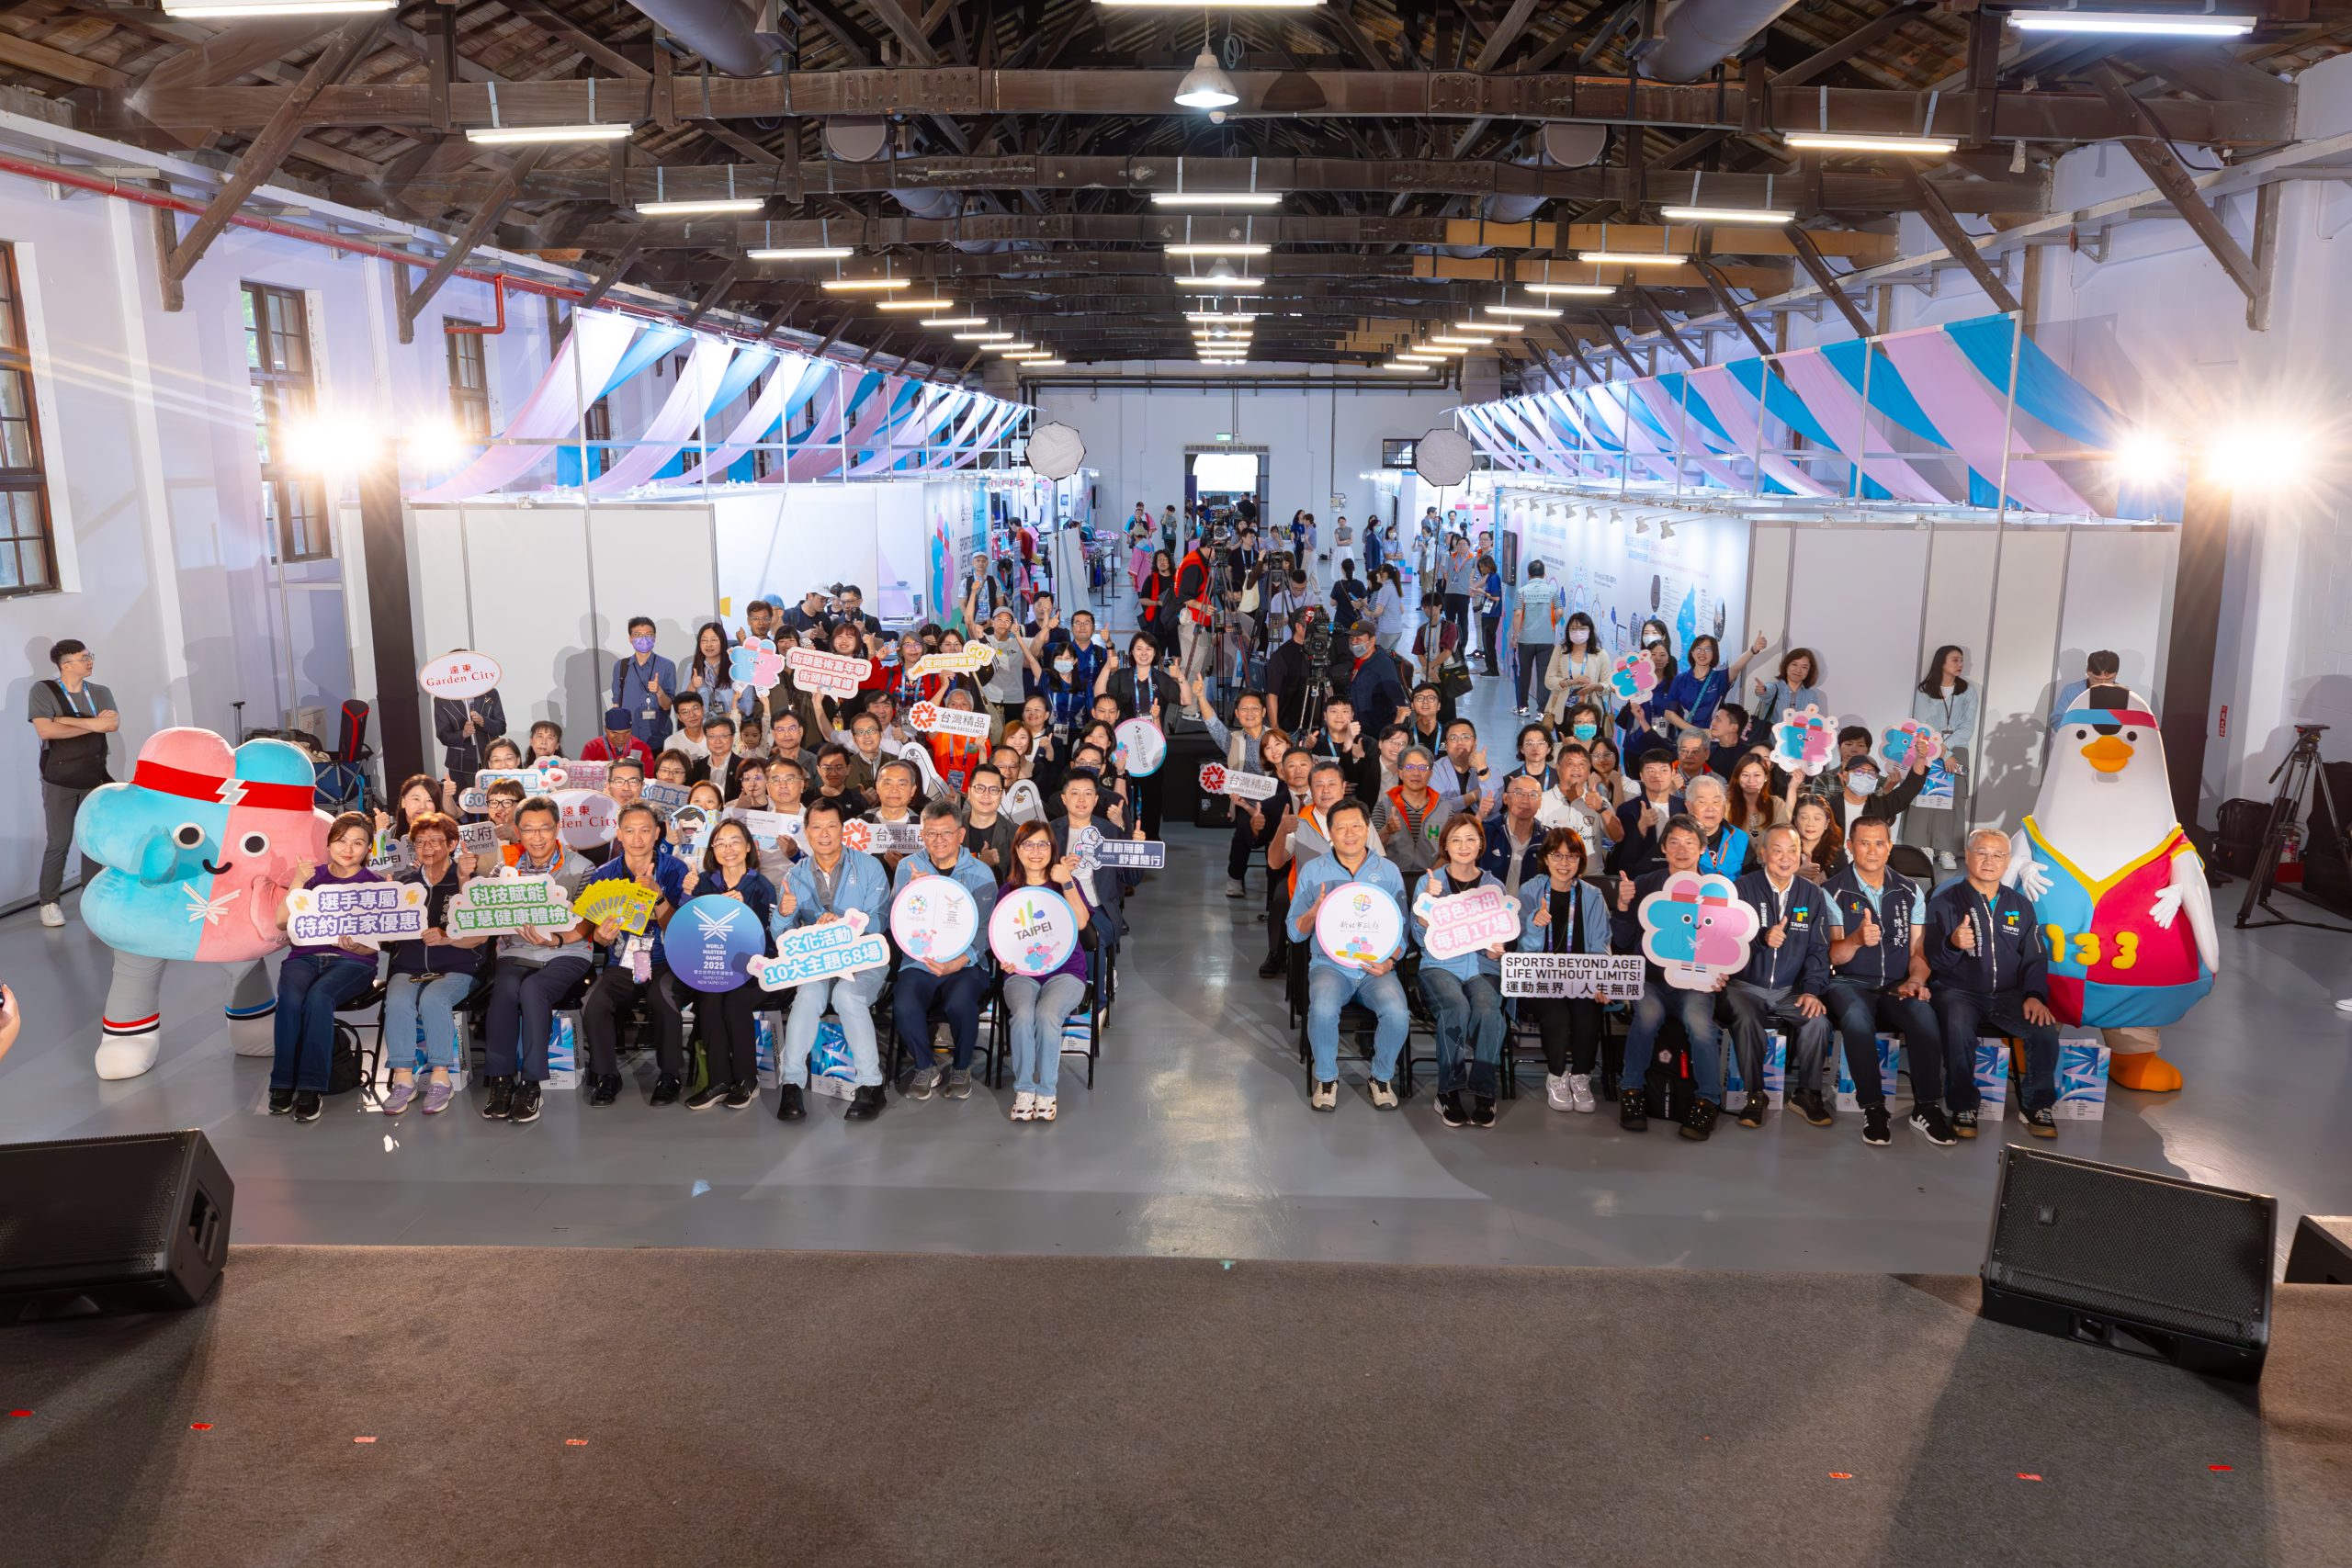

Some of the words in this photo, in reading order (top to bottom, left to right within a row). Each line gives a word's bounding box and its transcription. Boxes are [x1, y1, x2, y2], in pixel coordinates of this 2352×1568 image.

[967, 644, 990, 661] GO!
[426, 675, 467, 687] Garden
[471, 671, 495, 681] City
[940, 711, 986, 728] 台灣精品
[957, 725, 984, 735] EXCELLENCE
[1229, 773, 1273, 792] 台灣精品
[562, 805, 590, 817] 遠東
[590, 816, 618, 831] City
[319, 888, 398, 911] 選手專屬
[470, 883, 548, 906] 科技賦能
[1433, 892, 1500, 925] 特色演出
[295, 910, 421, 938] 特約店家優惠
[455, 905, 569, 930] 智慧健康體檢
[1014, 921, 1053, 941] TAIPEI
[2002, 924, 2020, 933] TAIPEI
[785, 924, 853, 956] 文化活動
[2045, 923, 2139, 969] 133
[703, 961, 725, 969] 2025
[764, 940, 883, 985] 10大主題68場
[1506, 957, 1555, 967] SPORTS
[1558, 958, 1609, 968] BEYOND
[1612, 959, 1641, 970] AGE!
[1506, 969, 1532, 978] LIFE
[1535, 969, 1592, 980] WITHOUT
[1596, 970, 1641, 981] LIMITS!
[1506, 981, 1564, 995] 運動無界
[1580, 982, 1640, 996] 人生無限
